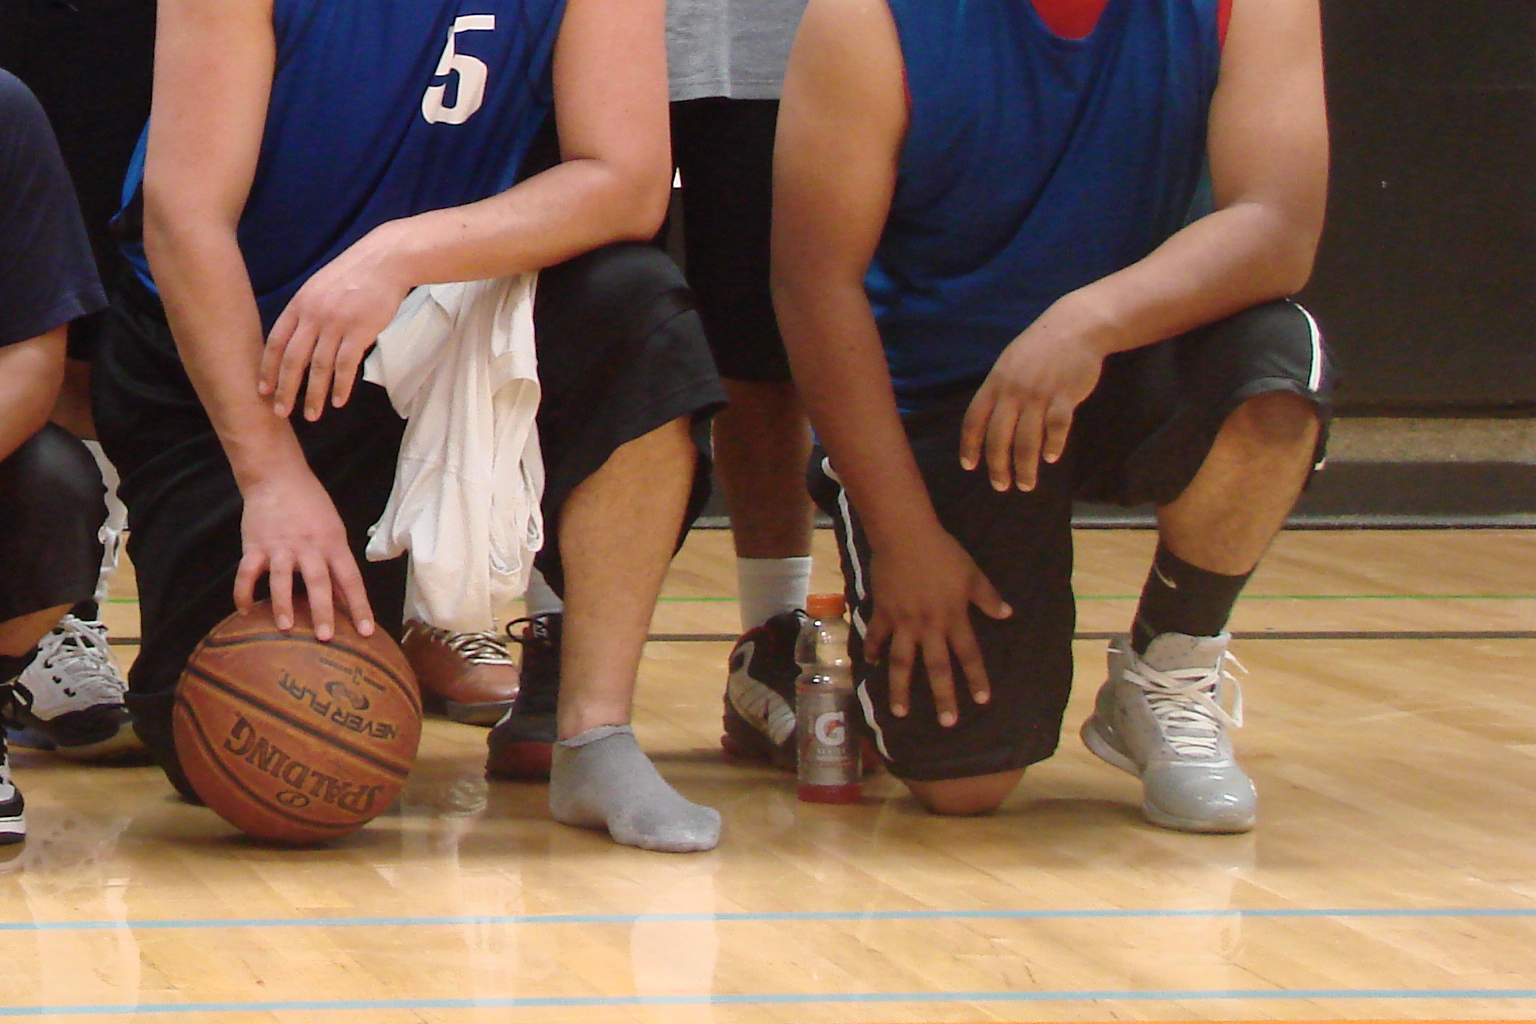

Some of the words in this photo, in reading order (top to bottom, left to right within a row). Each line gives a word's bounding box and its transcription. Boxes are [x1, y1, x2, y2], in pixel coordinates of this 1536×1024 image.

[421, 14, 496, 125] 5
[278, 672, 331, 718] FLAT
[330, 708, 398, 740] NEVER
[814, 711, 845, 746] G
[222, 715, 386, 815] SPALDING
